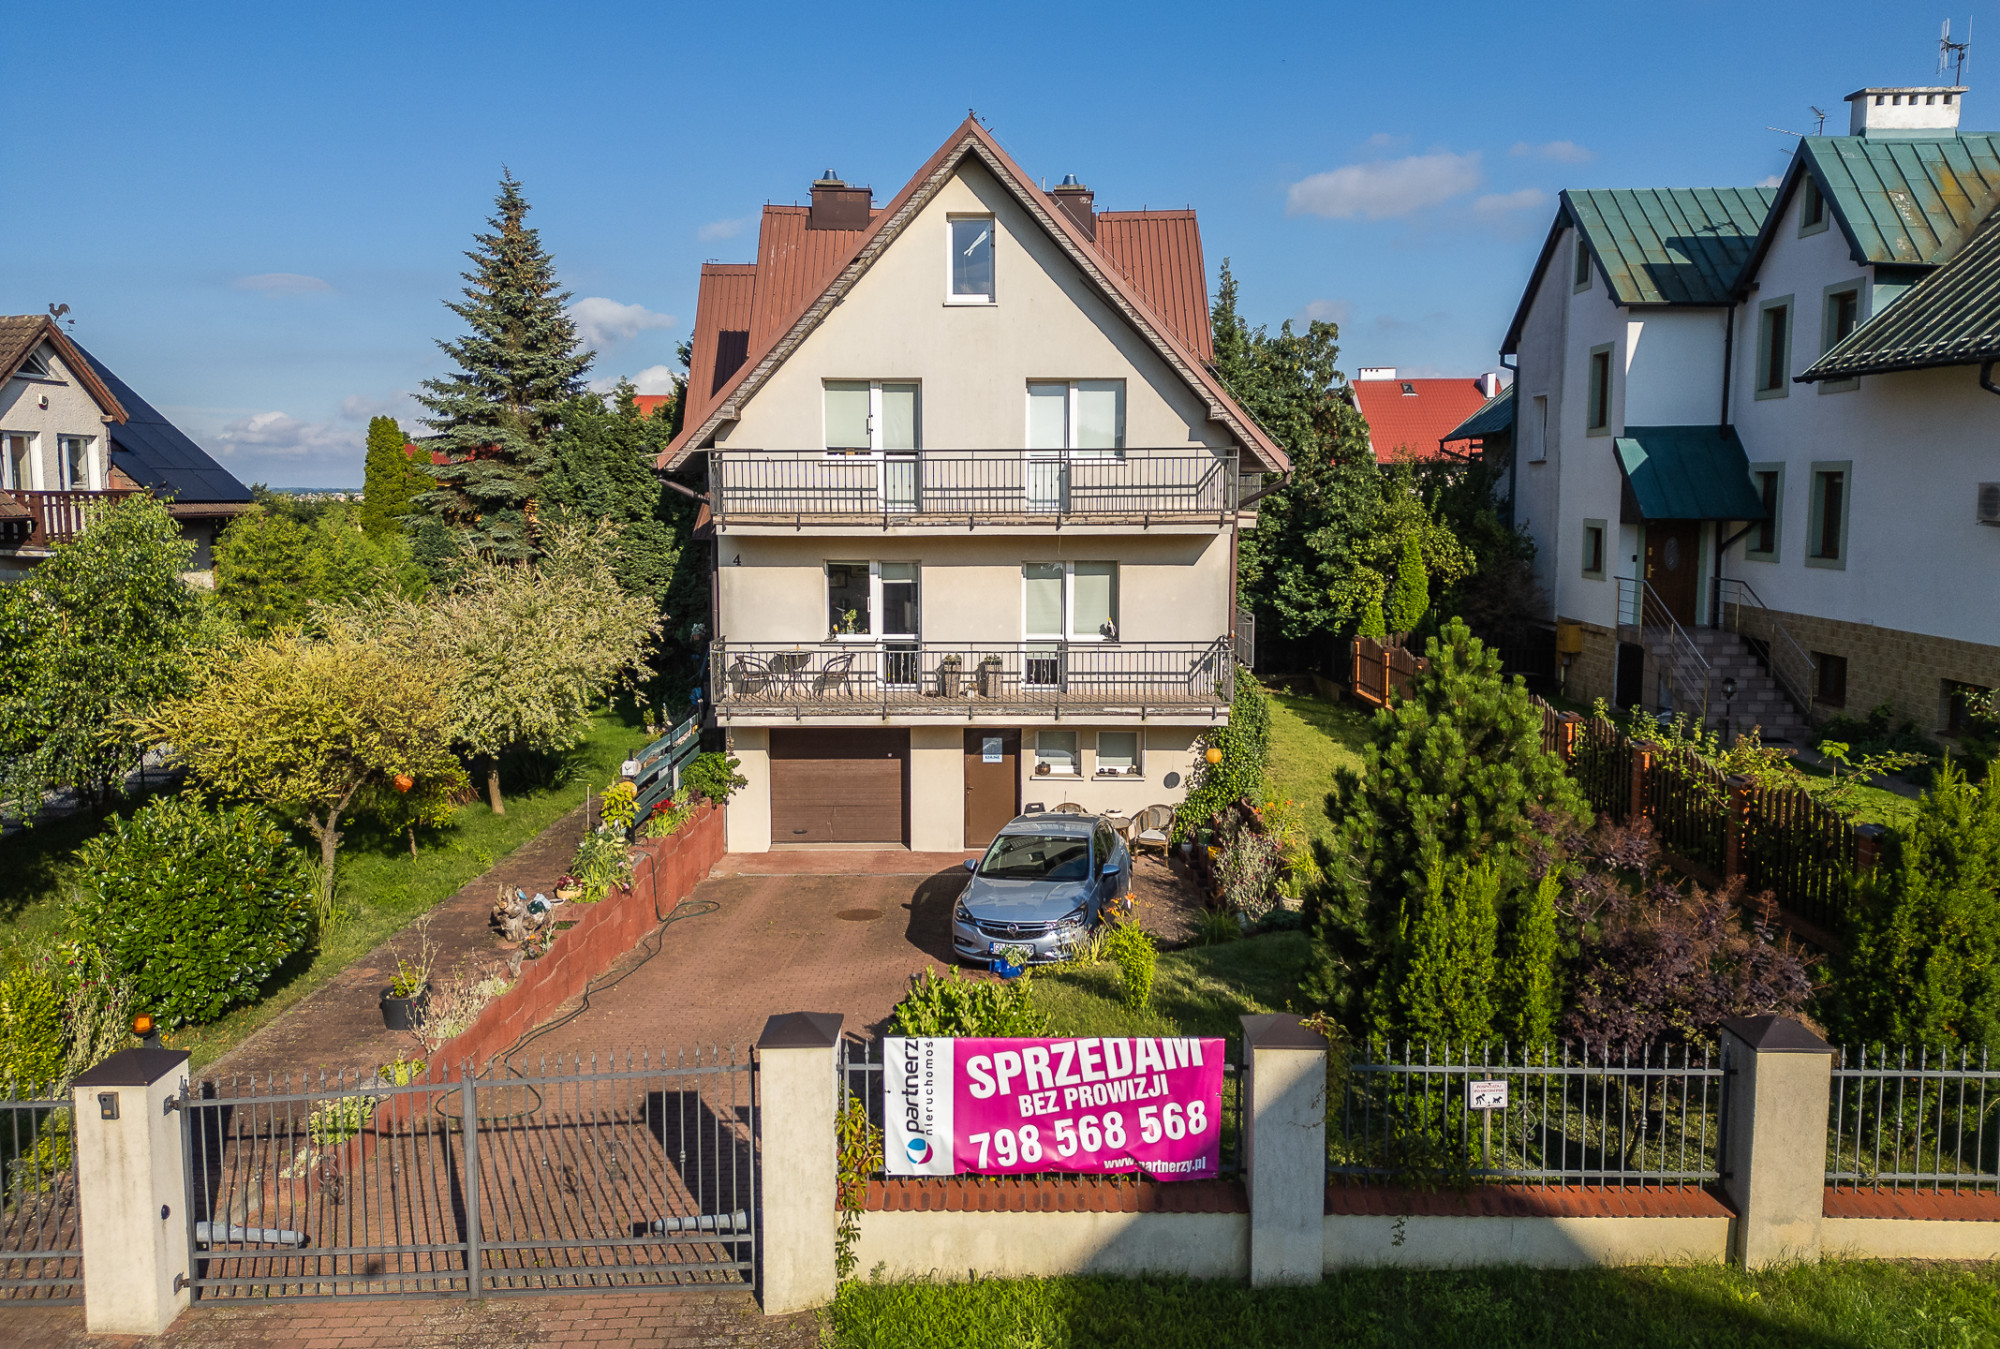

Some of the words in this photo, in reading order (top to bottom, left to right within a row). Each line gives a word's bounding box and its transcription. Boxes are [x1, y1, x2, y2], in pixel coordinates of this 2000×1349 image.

[732, 553, 742, 566] 4
[924, 1037, 934, 1136] nieruchomoś
[966, 1037, 1204, 1099] SPRZEDAM
[1018, 1090, 1060, 1118] BEZ
[1063, 1073, 1169, 1110] PROWIZJI
[968, 1124, 1043, 1169] 798
[1054, 1111, 1127, 1157] 568
[1138, 1100, 1208, 1144] 568
